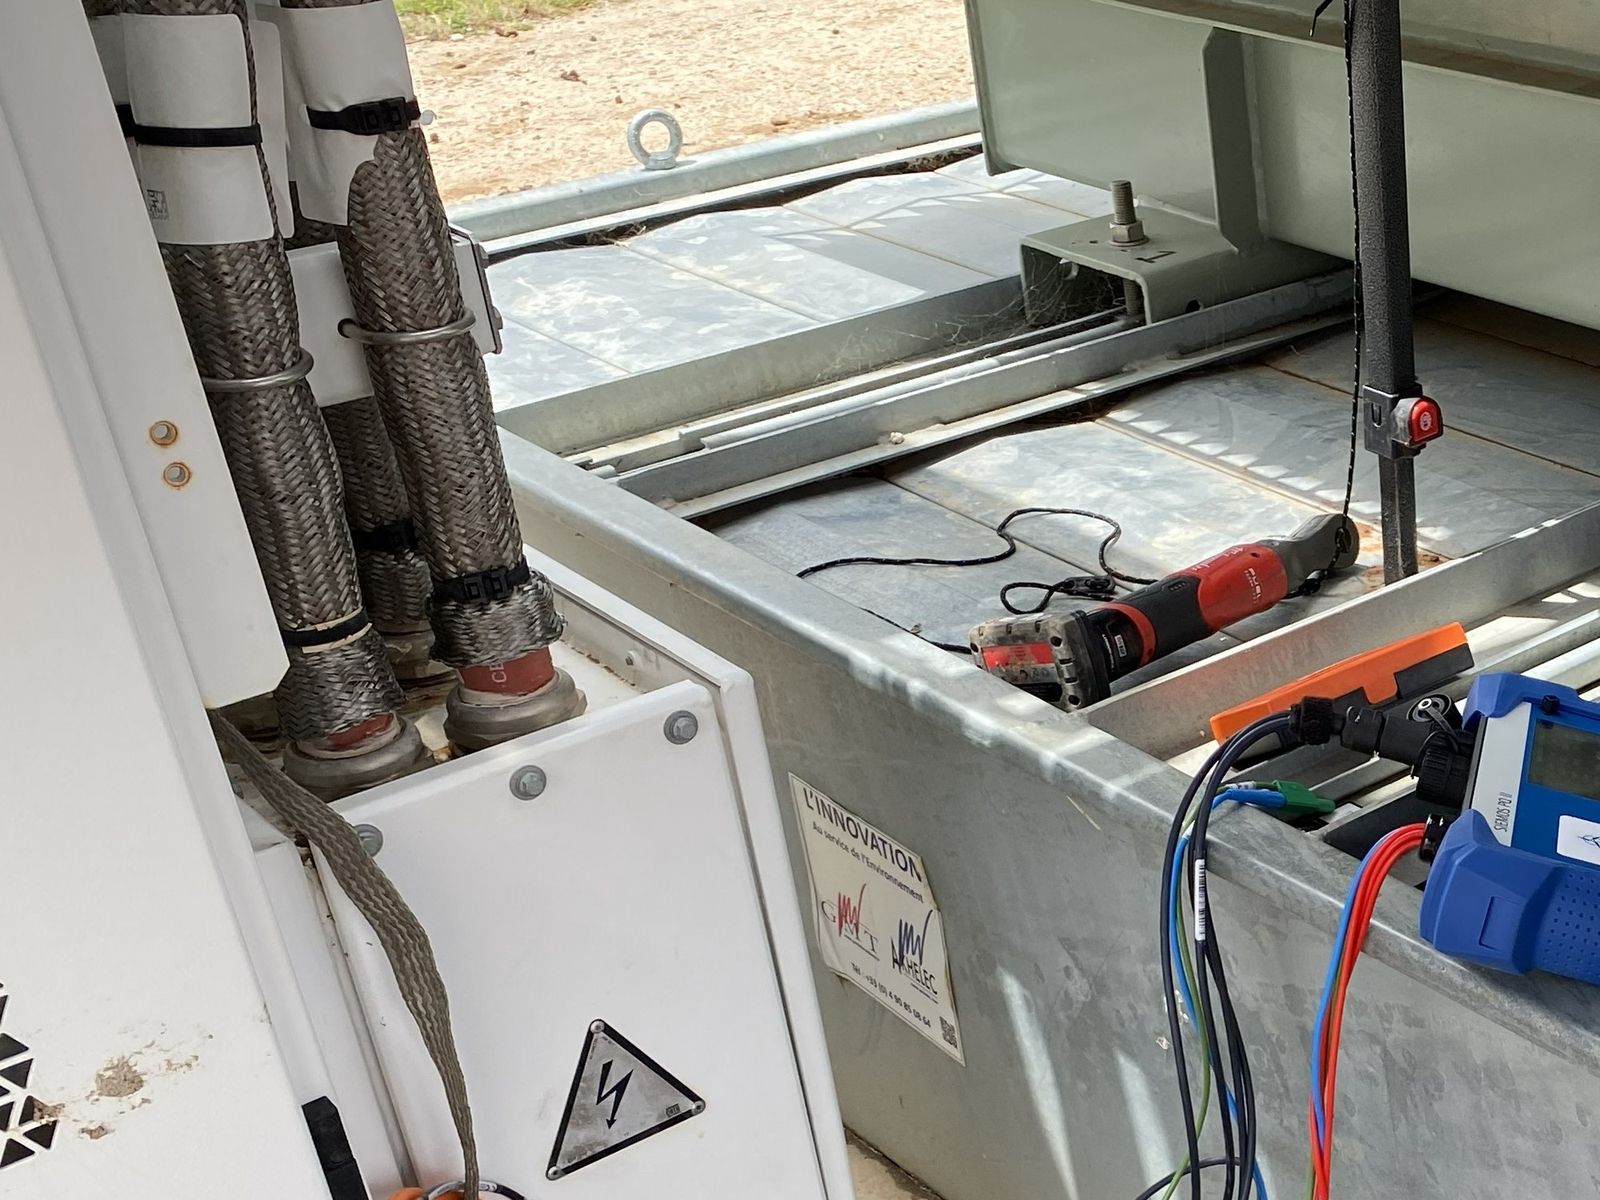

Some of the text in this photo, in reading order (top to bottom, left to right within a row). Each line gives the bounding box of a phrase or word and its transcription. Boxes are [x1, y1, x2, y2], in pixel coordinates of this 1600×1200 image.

[802, 787, 922, 882] L'INNOVATION
[813, 821, 823, 835] Au
[823, 830, 849, 853] service
[850, 847, 861, 861] de
